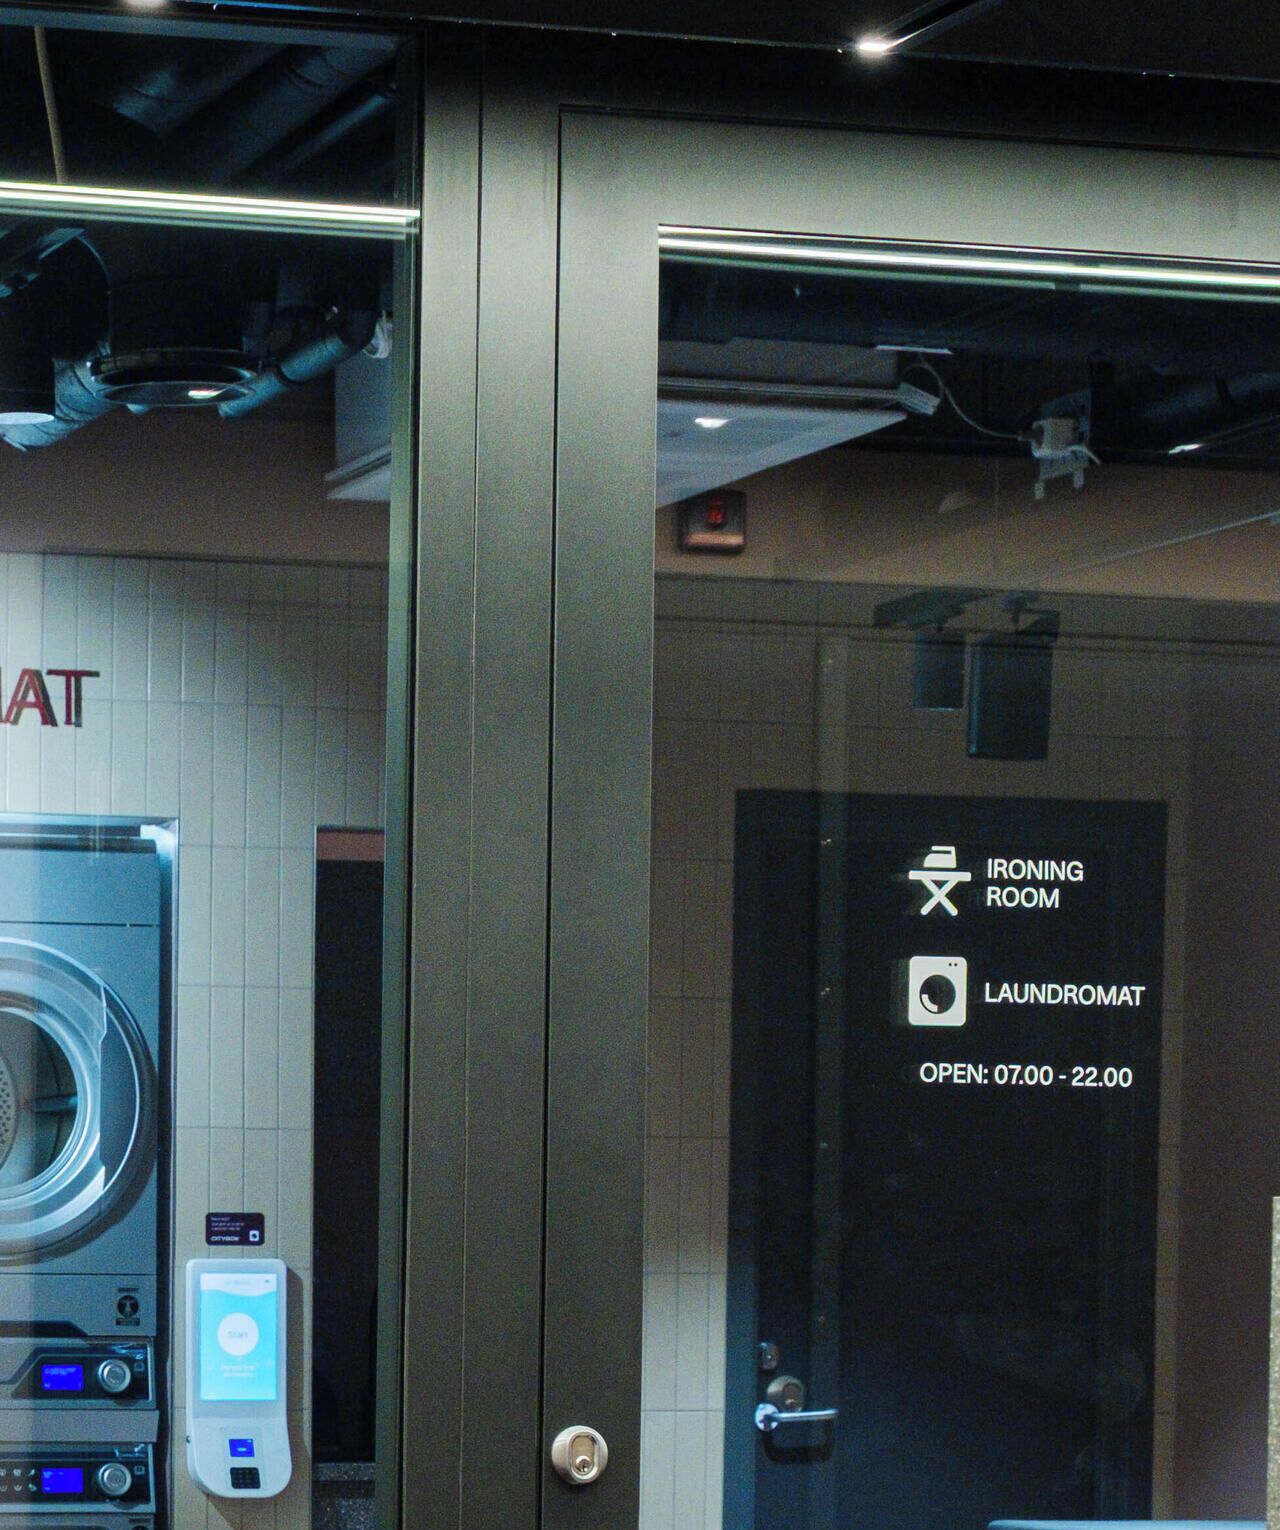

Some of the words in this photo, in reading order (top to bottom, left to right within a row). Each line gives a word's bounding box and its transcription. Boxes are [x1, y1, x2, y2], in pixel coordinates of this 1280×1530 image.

[987, 858, 1085, 882] IRONING
[986, 886, 1060, 908] ROOM
[984, 982, 1146, 1007] LAUNDROMAT
[919, 1062, 989, 1085] OPEN:
[994, 1064, 1054, 1086] 07.00
[1071, 1066, 1133, 1088] 22.00
